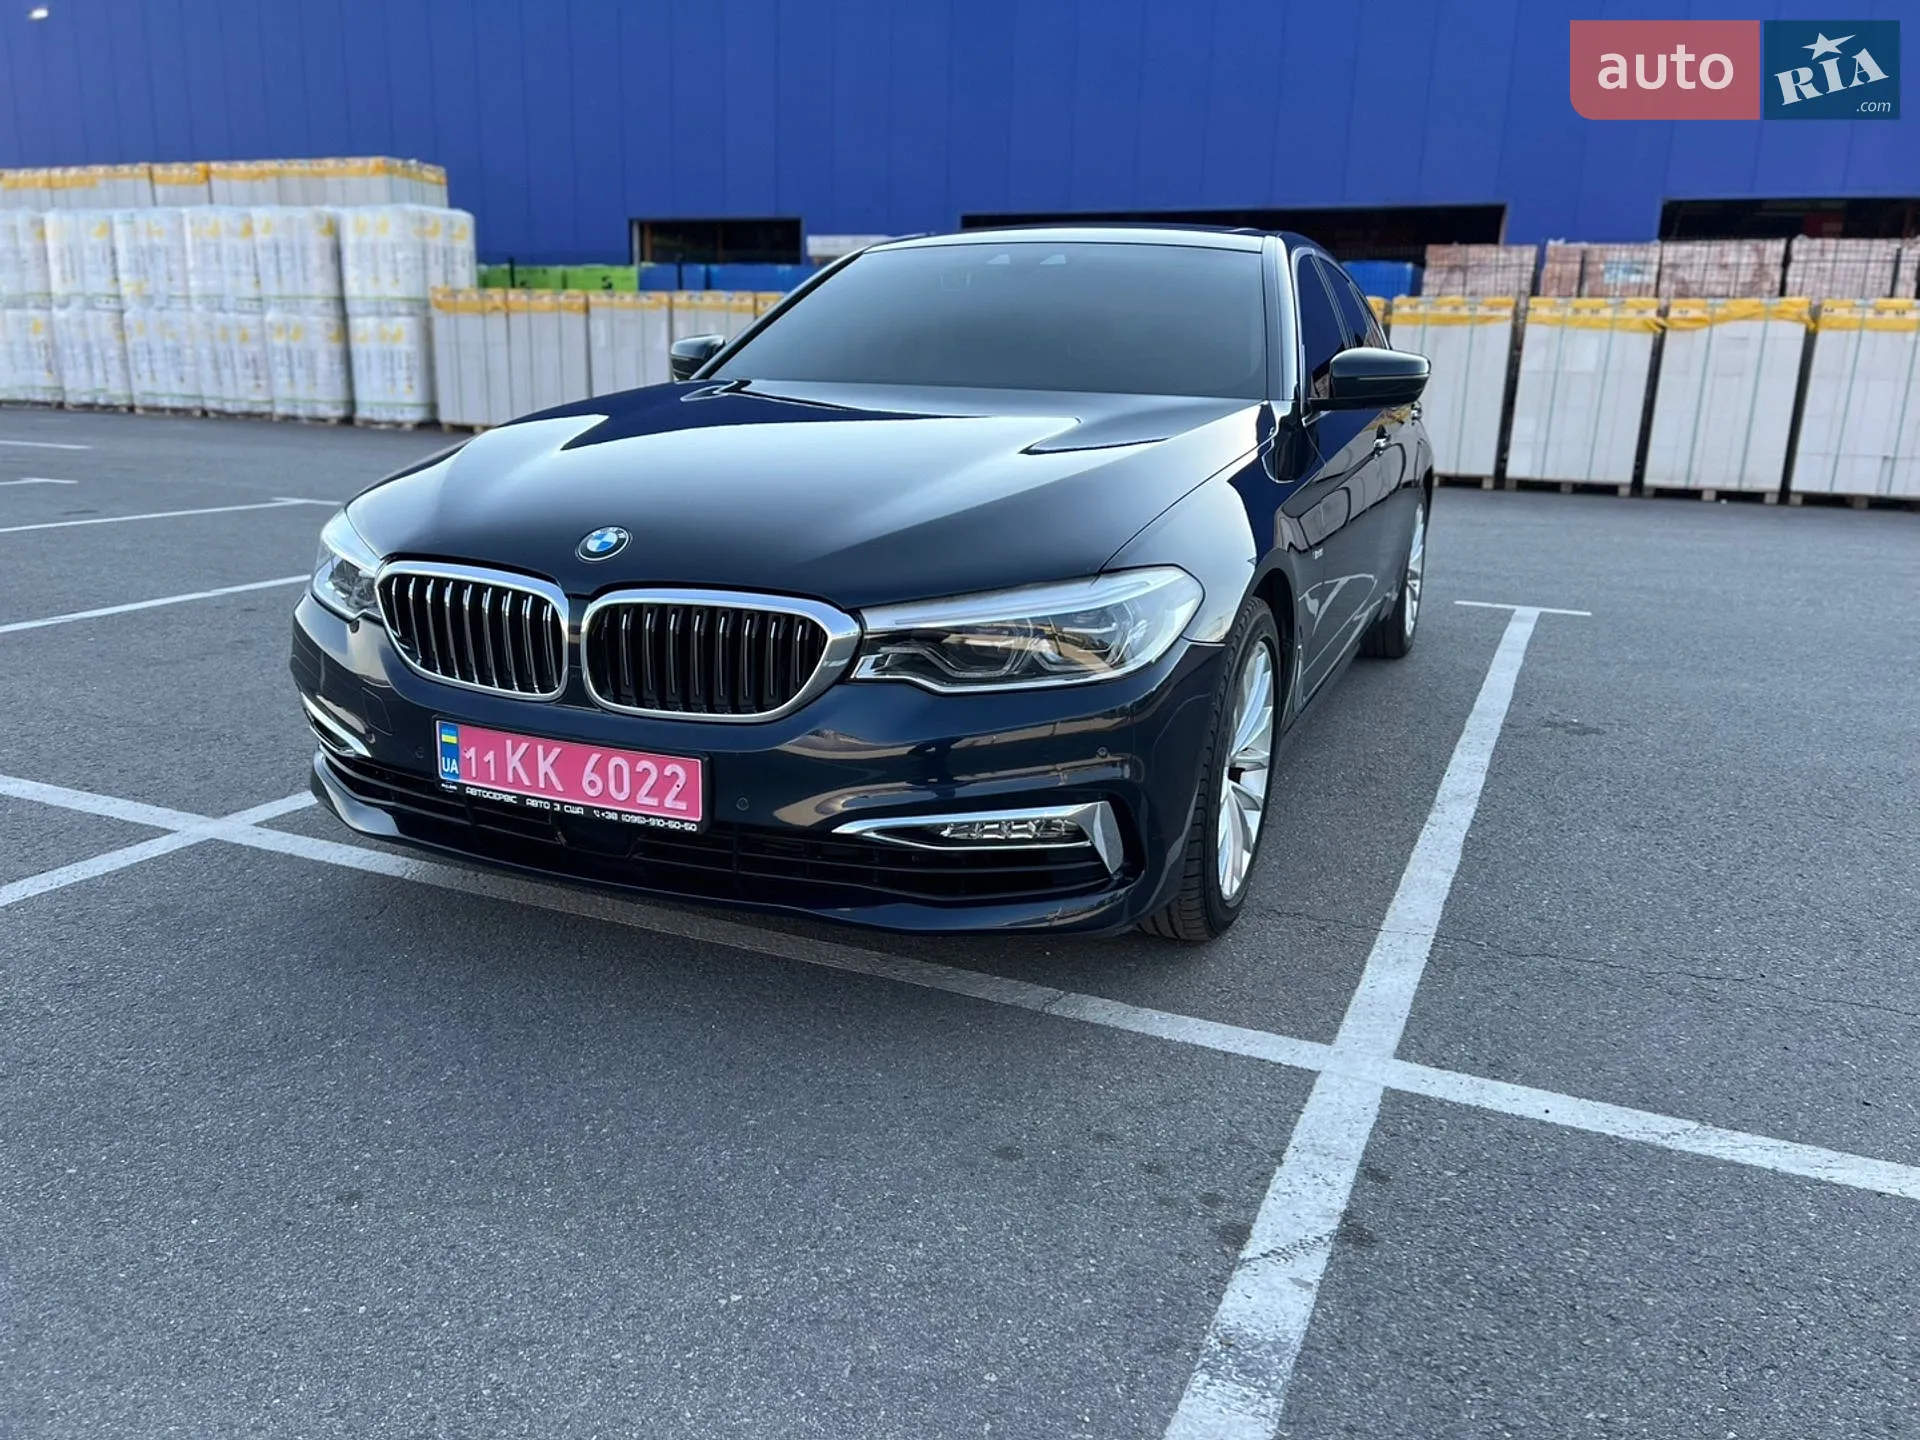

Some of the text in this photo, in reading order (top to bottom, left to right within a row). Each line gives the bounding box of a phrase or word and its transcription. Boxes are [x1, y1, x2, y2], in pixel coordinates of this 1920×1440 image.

[441, 756, 459, 775] UA
[581, 753, 688, 811] 6022
[525, 798, 551, 810] АВТО
